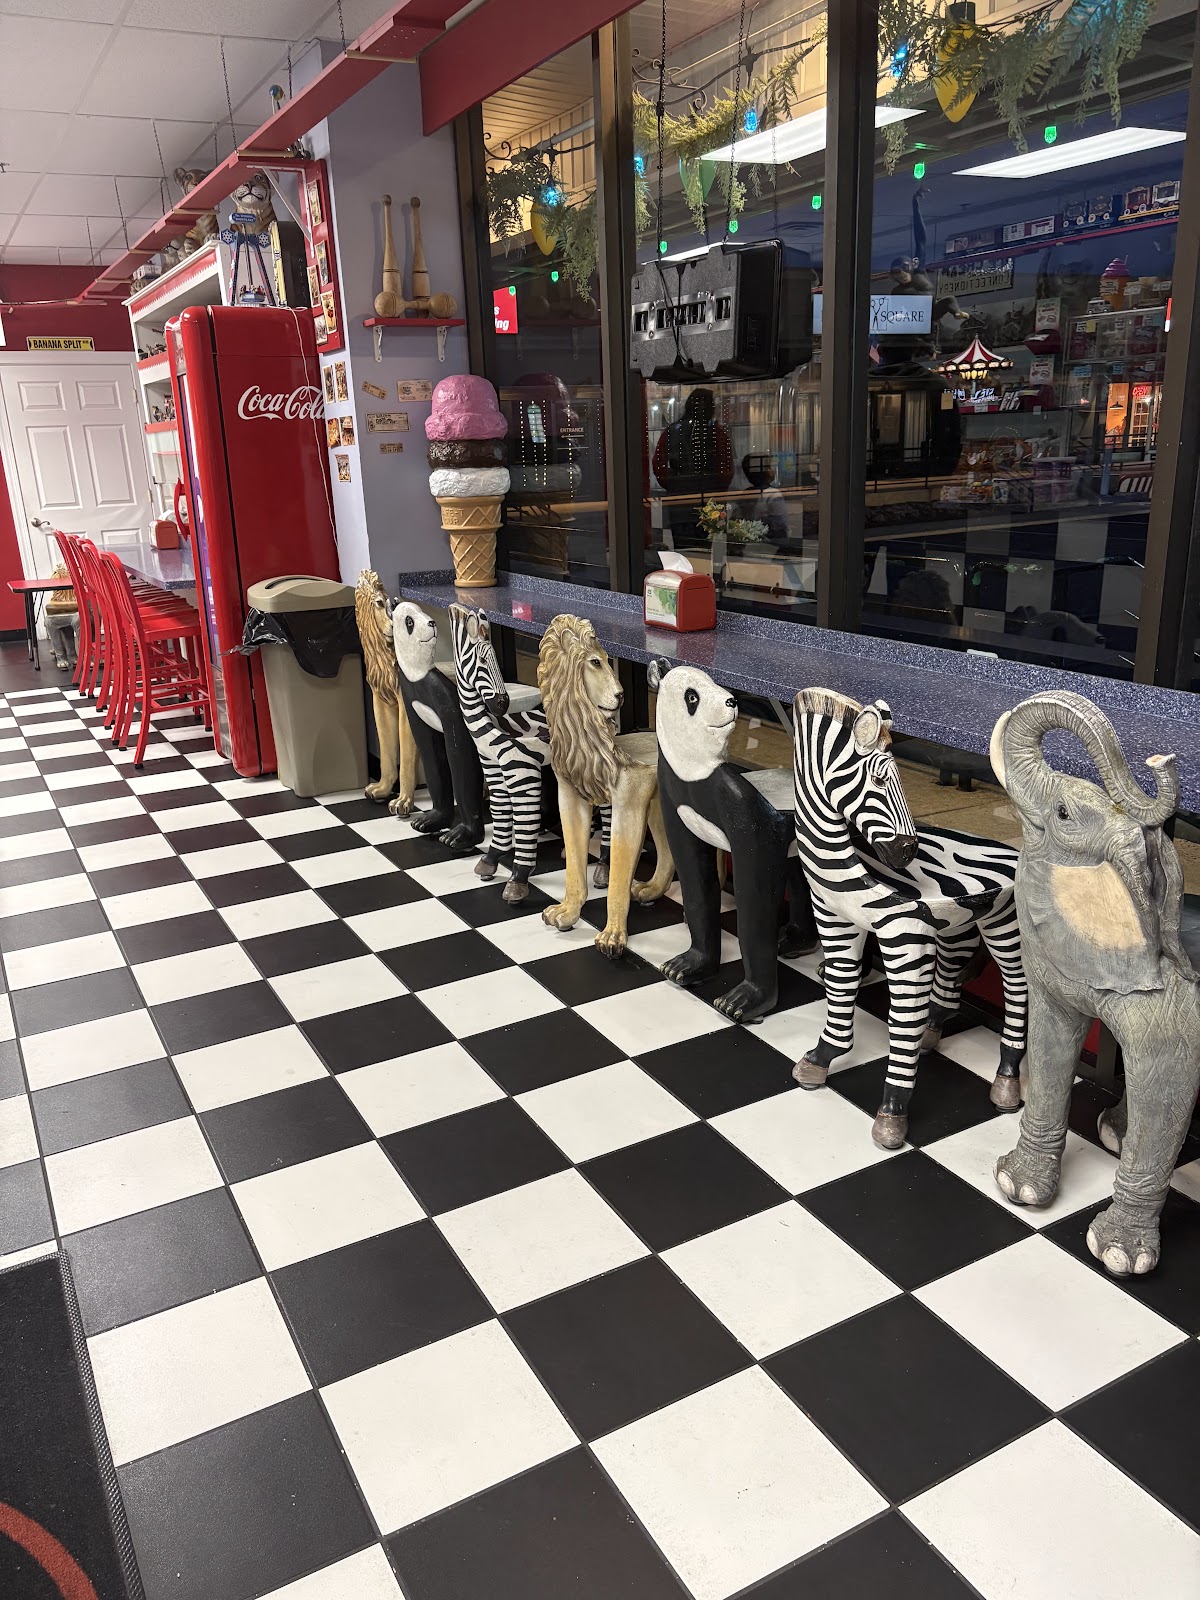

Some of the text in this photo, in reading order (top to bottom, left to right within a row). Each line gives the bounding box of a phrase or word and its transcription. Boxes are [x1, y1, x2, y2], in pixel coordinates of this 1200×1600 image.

[880, 310, 925, 324] SQUARE
[33, 339, 62, 349] BANANA
[63, 340, 81, 349] SPLIT
